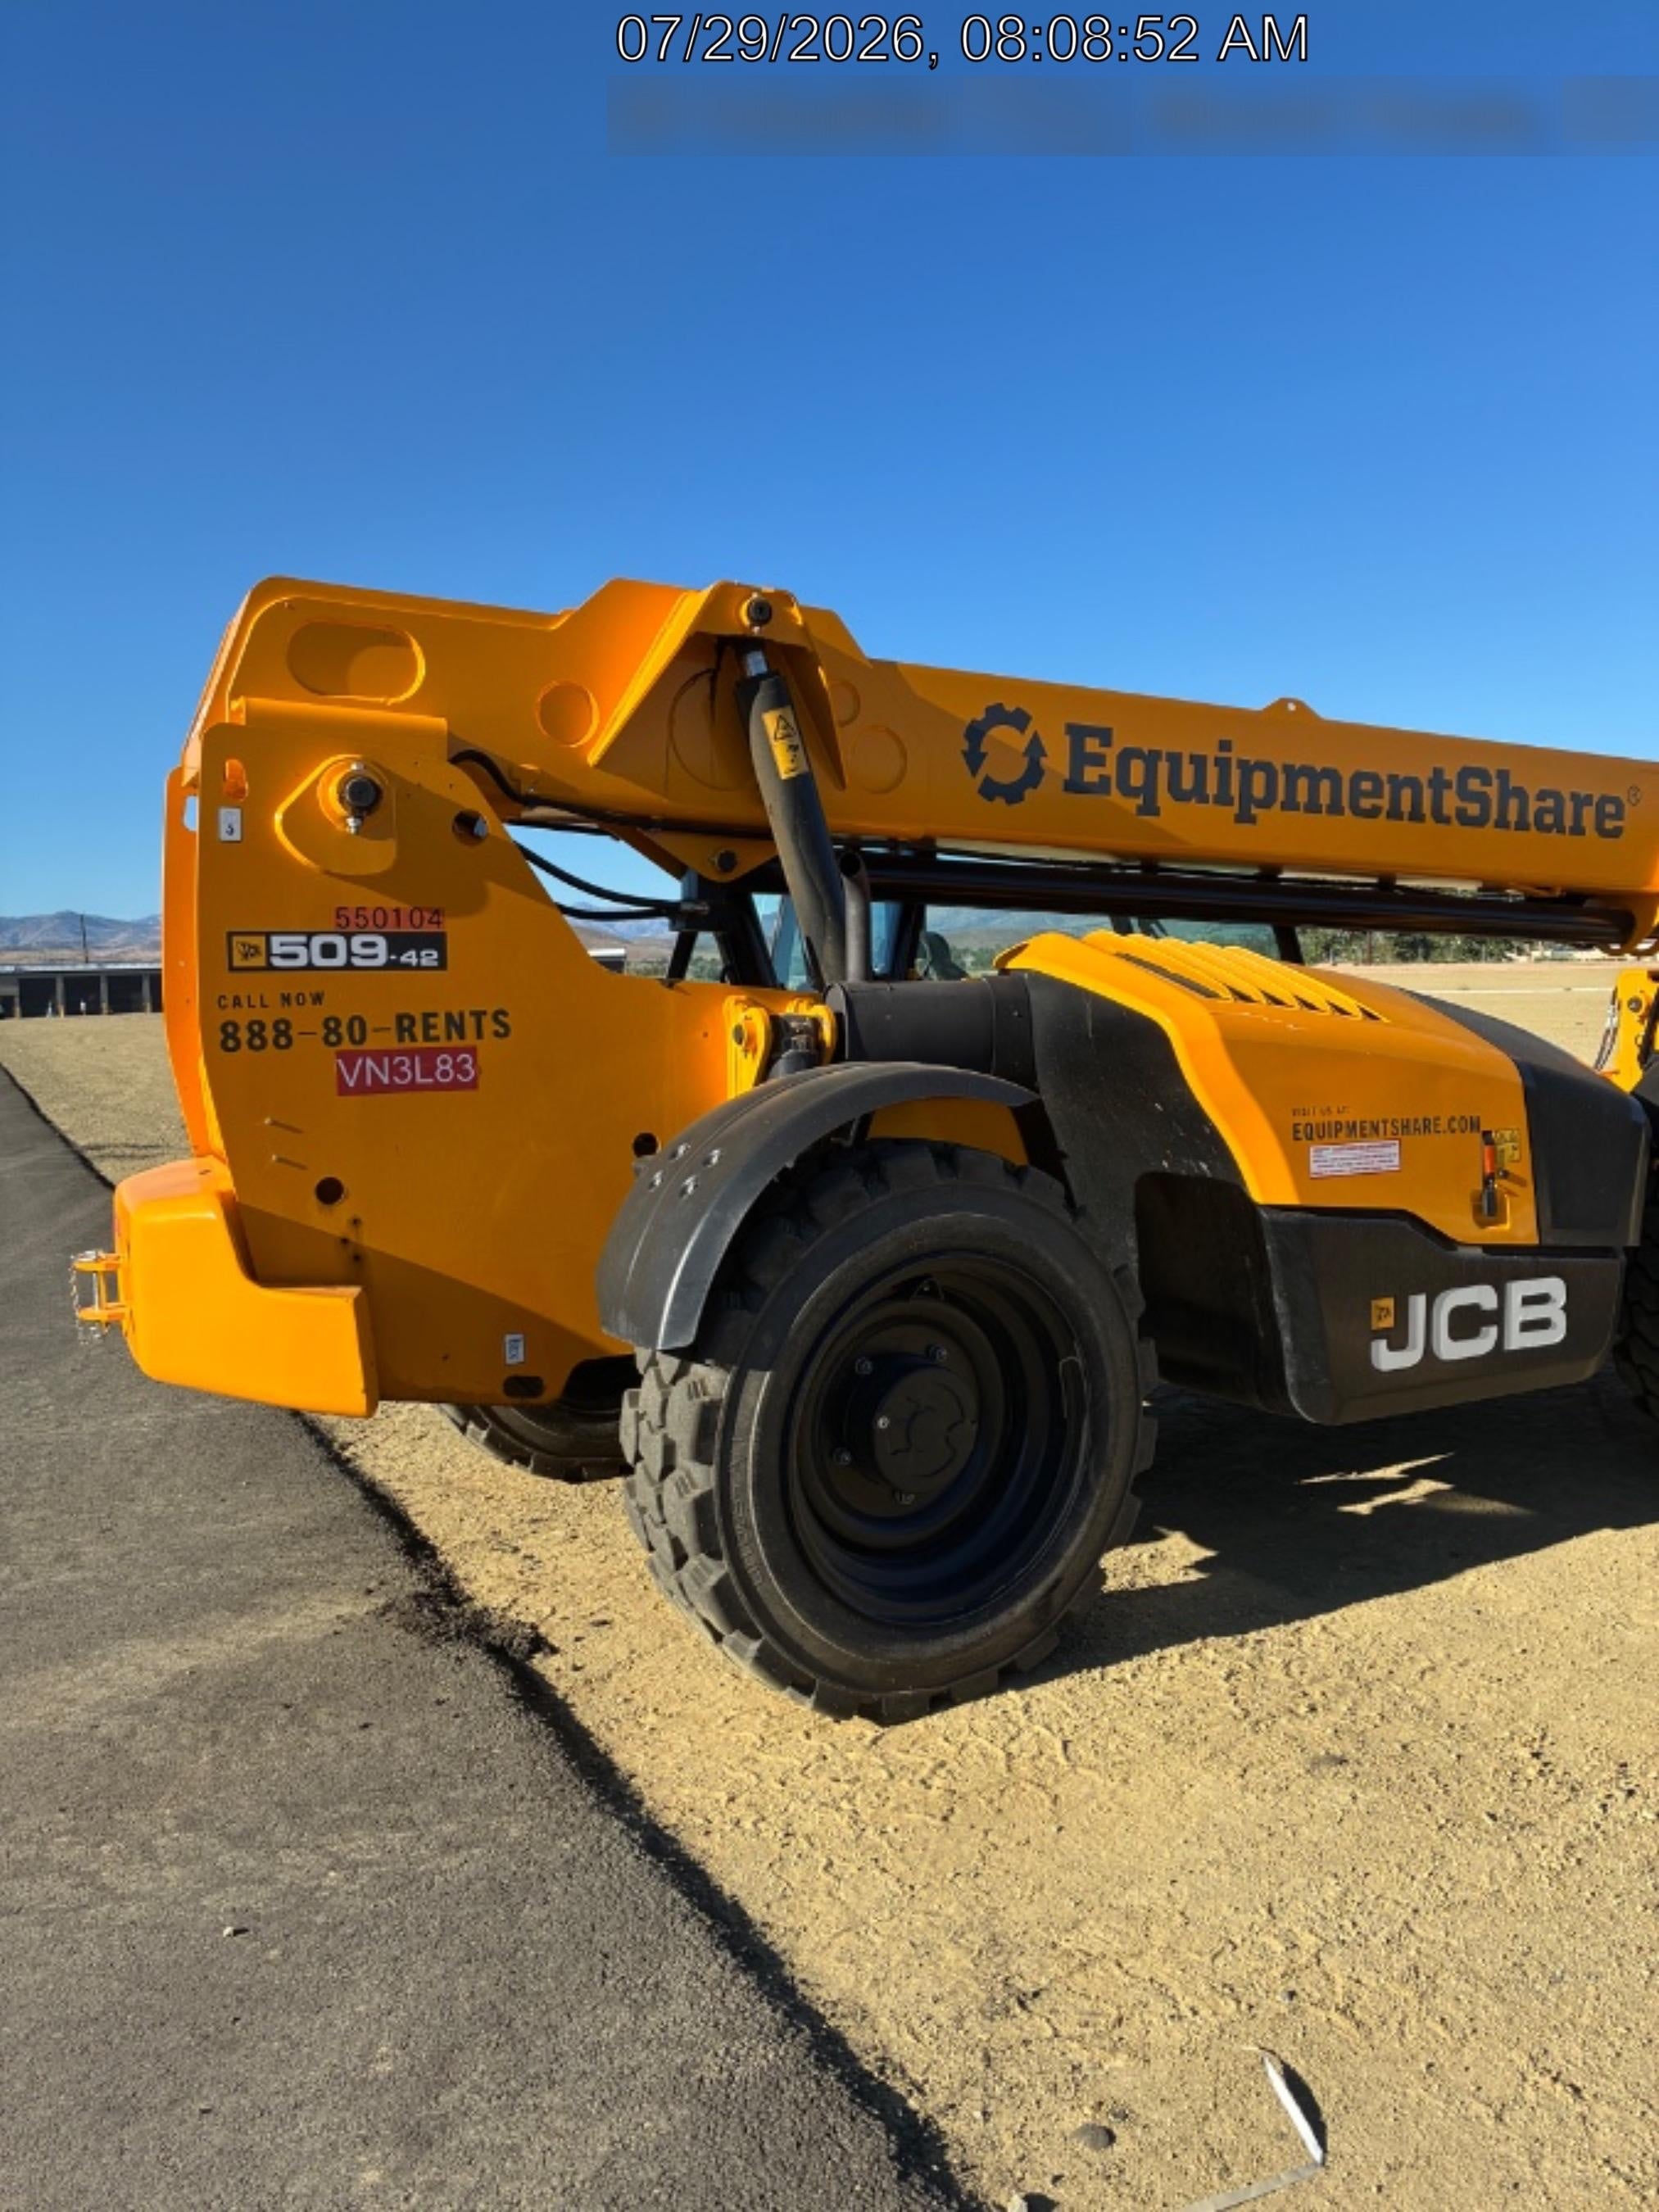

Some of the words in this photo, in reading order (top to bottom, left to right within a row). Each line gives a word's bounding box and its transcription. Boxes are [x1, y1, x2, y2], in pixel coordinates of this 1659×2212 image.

[1064, 722, 1626, 840] EquipmentShare
[335, 906, 443, 930] 550104
[217, 993, 270, 1010] CALL
[279, 991, 324, 1007] NOW
[219, 1009, 511, 1053] 888-80-RENTS
[338, 1054, 476, 1088] VN3L83
[1371, 1276, 1567, 1372] JCB
